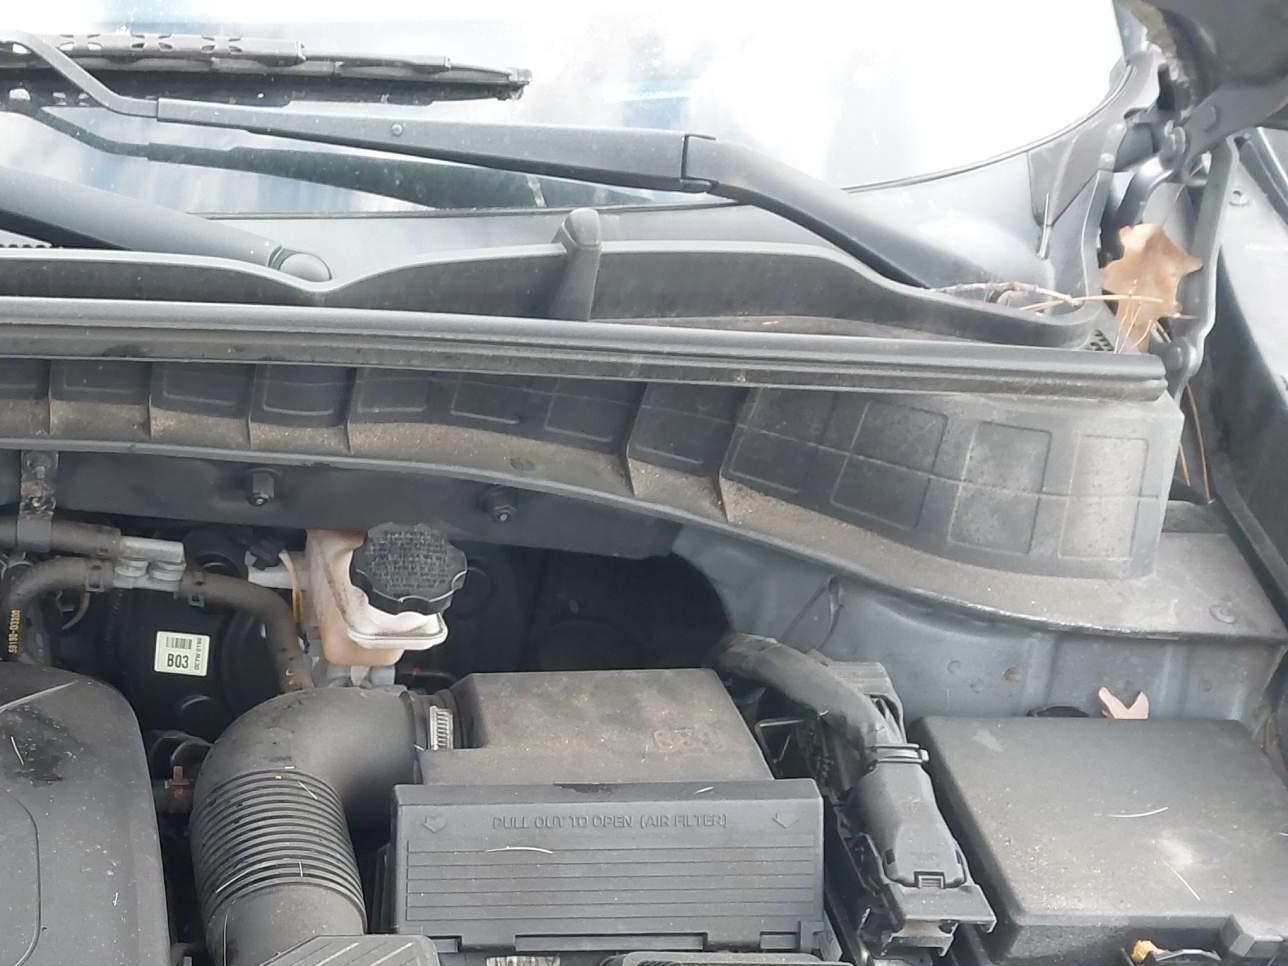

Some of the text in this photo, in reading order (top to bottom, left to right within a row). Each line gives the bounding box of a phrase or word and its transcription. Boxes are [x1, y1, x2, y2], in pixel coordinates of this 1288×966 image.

[167, 653, 189, 669] B03
[492, 815, 528, 830] PULL
[534, 815, 563, 830] OUT
[568, 815, 588, 830] TO
[592, 815, 633, 829] OPEN
